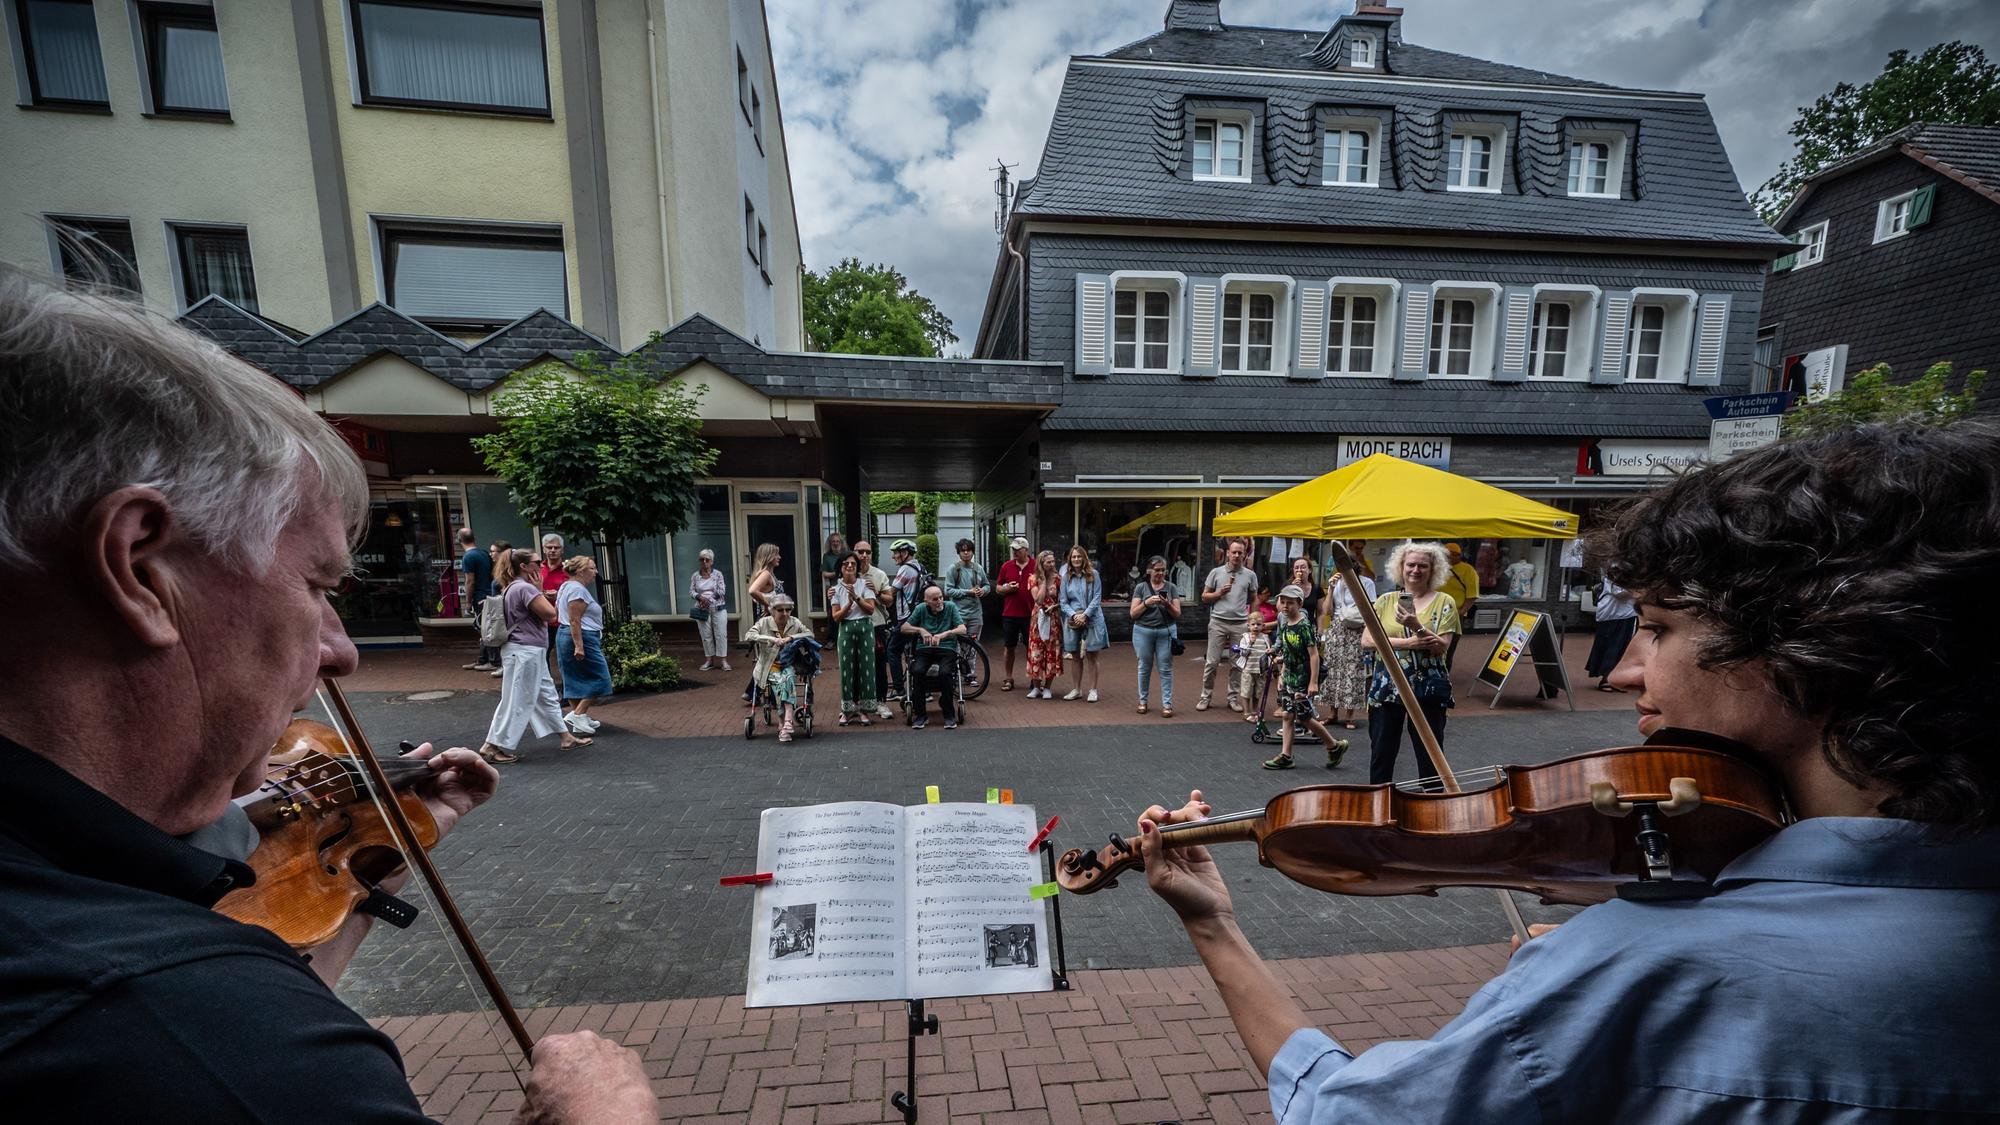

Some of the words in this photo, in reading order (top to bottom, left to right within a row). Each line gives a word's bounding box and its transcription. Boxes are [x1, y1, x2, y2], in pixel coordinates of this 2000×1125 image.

[1722, 396, 1778, 409] Parkschein
[1727, 405, 1770, 417] Automat
[1734, 421, 1757, 429] Hier
[1716, 429, 1775, 440] Parkschein
[1346, 441, 1395, 458] MODE
[1400, 442, 1442, 458] BACH
[1728, 440, 1758, 448] lösen
[1609, 453, 1642, 467] Ursels
